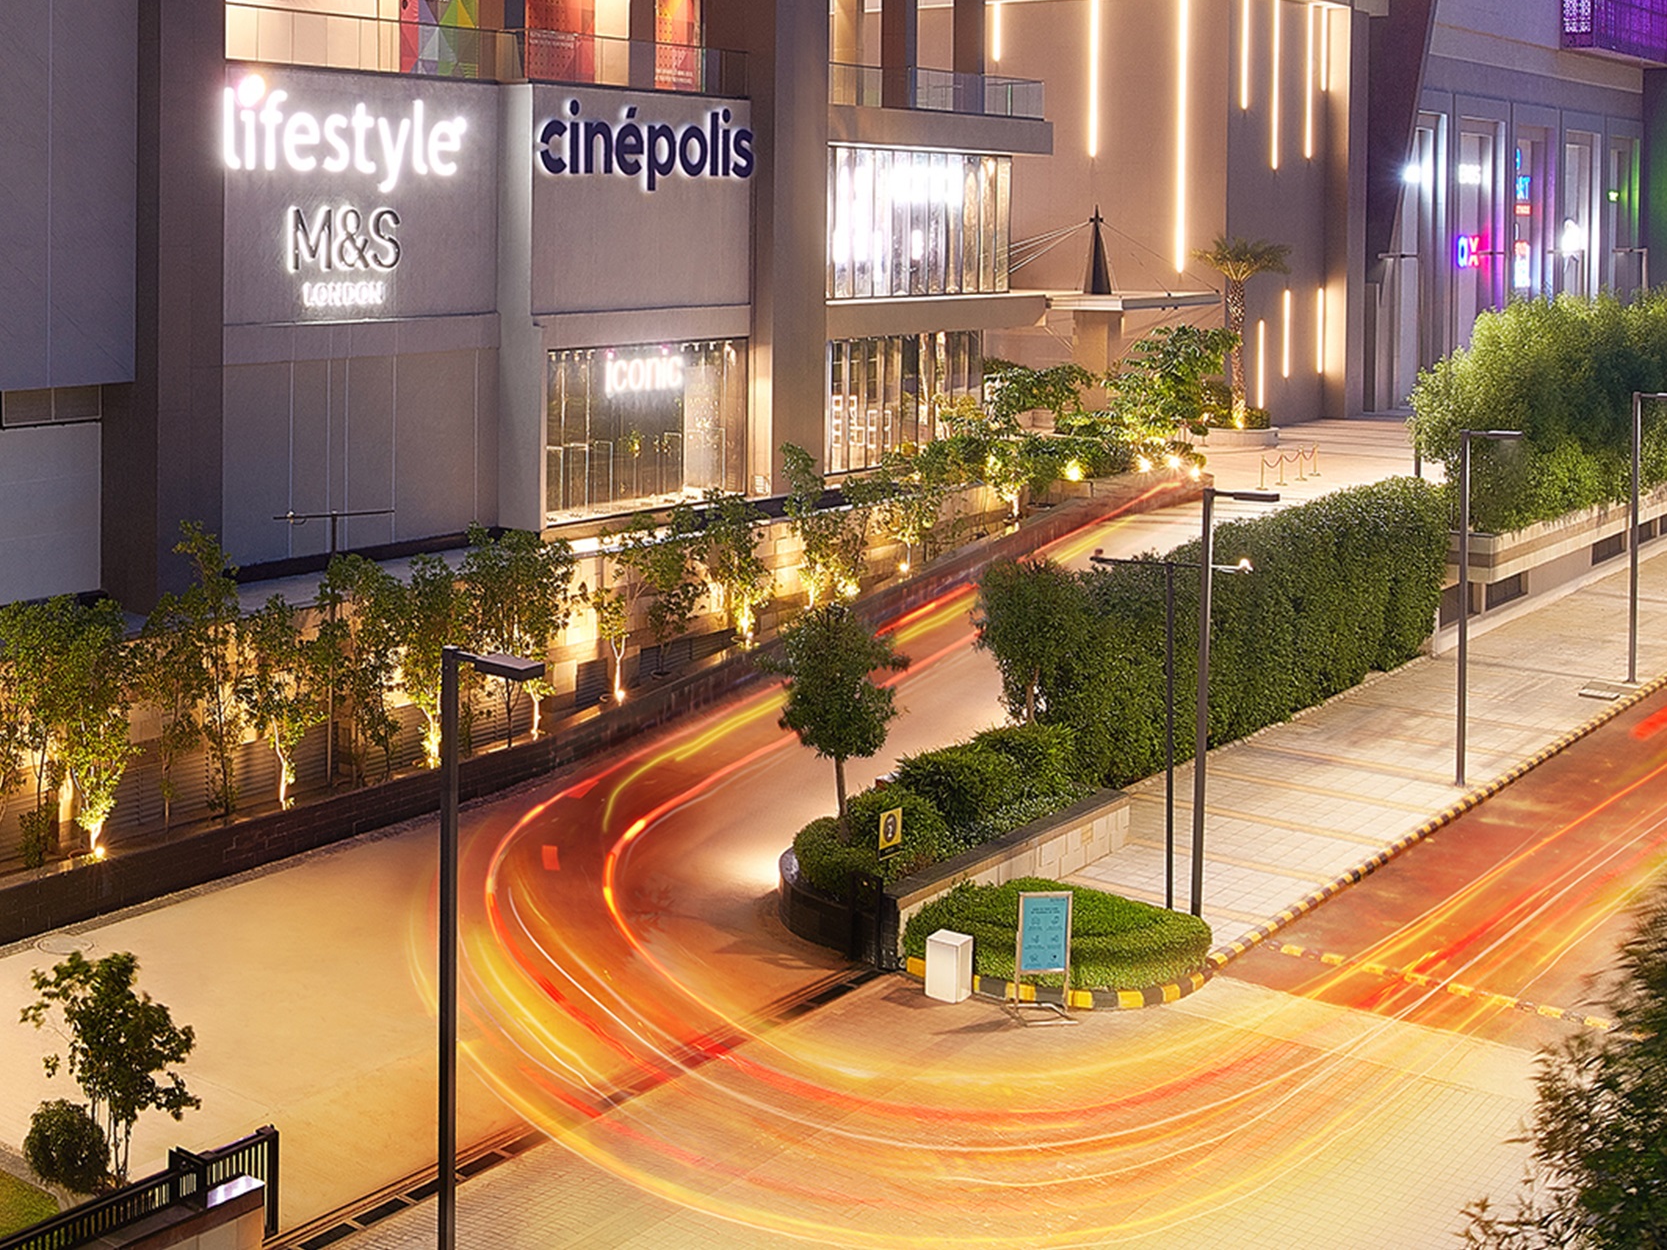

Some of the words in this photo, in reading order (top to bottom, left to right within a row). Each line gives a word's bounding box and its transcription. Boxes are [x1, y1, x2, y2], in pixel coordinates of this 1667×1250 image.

[223, 74, 467, 193] lifestyle
[539, 99, 754, 191] cinépolis
[287, 205, 401, 273] M&S
[303, 281, 386, 307] LONDON
[605, 344, 685, 399] iconic
